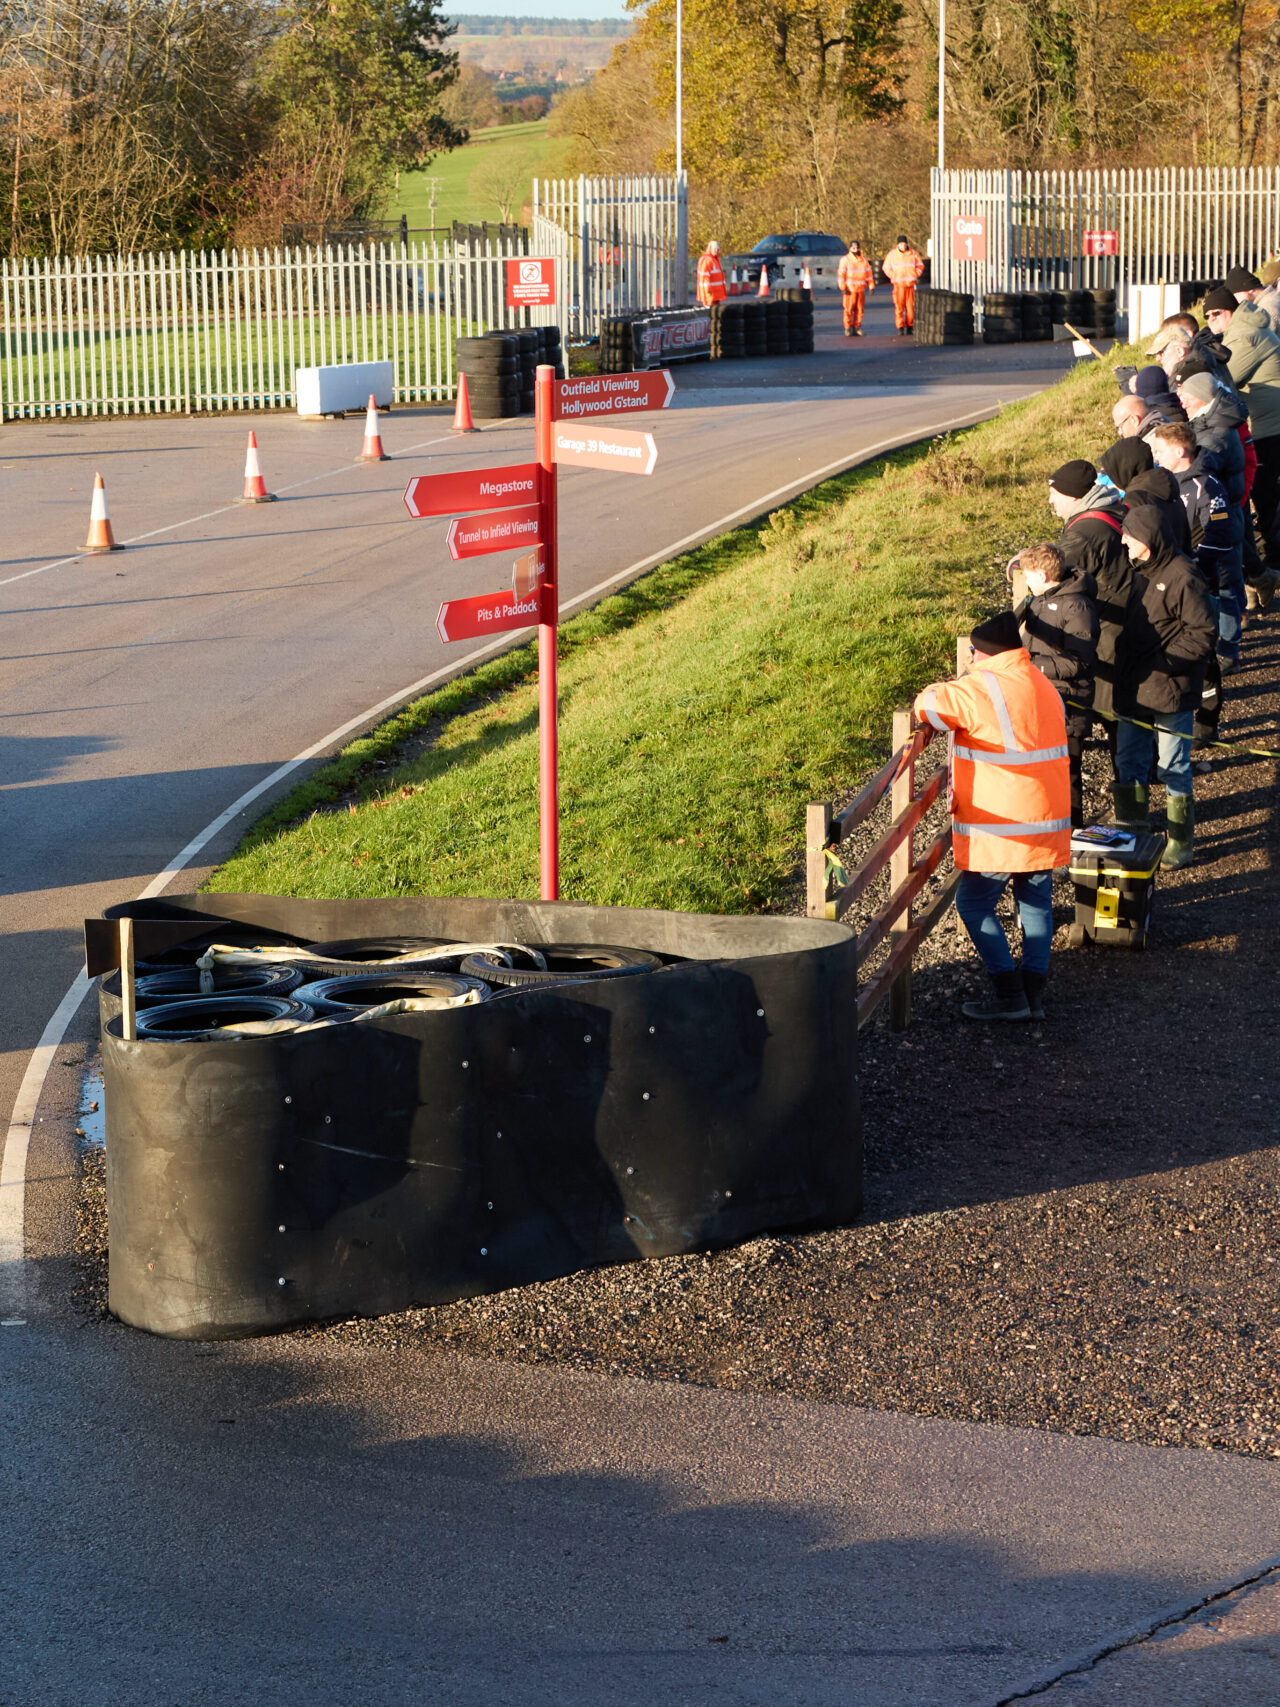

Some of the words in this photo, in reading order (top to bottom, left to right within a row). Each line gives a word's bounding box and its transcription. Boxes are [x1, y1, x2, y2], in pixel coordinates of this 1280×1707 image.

[956, 218, 983, 235] Gate
[964, 237, 972, 257] 1
[560, 381, 600, 396] Outfield
[602, 378, 639, 392] Viewing
[561, 397, 612, 415] Hollywood
[614, 393, 648, 408] G'stand
[557, 435, 586, 453] Garage
[587, 439, 597, 452] 39
[598, 440, 642, 458] Restaurant
[480, 480, 533, 496] Megastore
[458, 528, 480, 544] Tunnel
[482, 529, 489, 540] to
[490, 523, 511, 538] Infield
[511, 518, 538, 533] Viewing
[477, 608, 493, 622] Pits
[494, 605, 501, 618] &
[502, 599, 537, 617] Paddock
